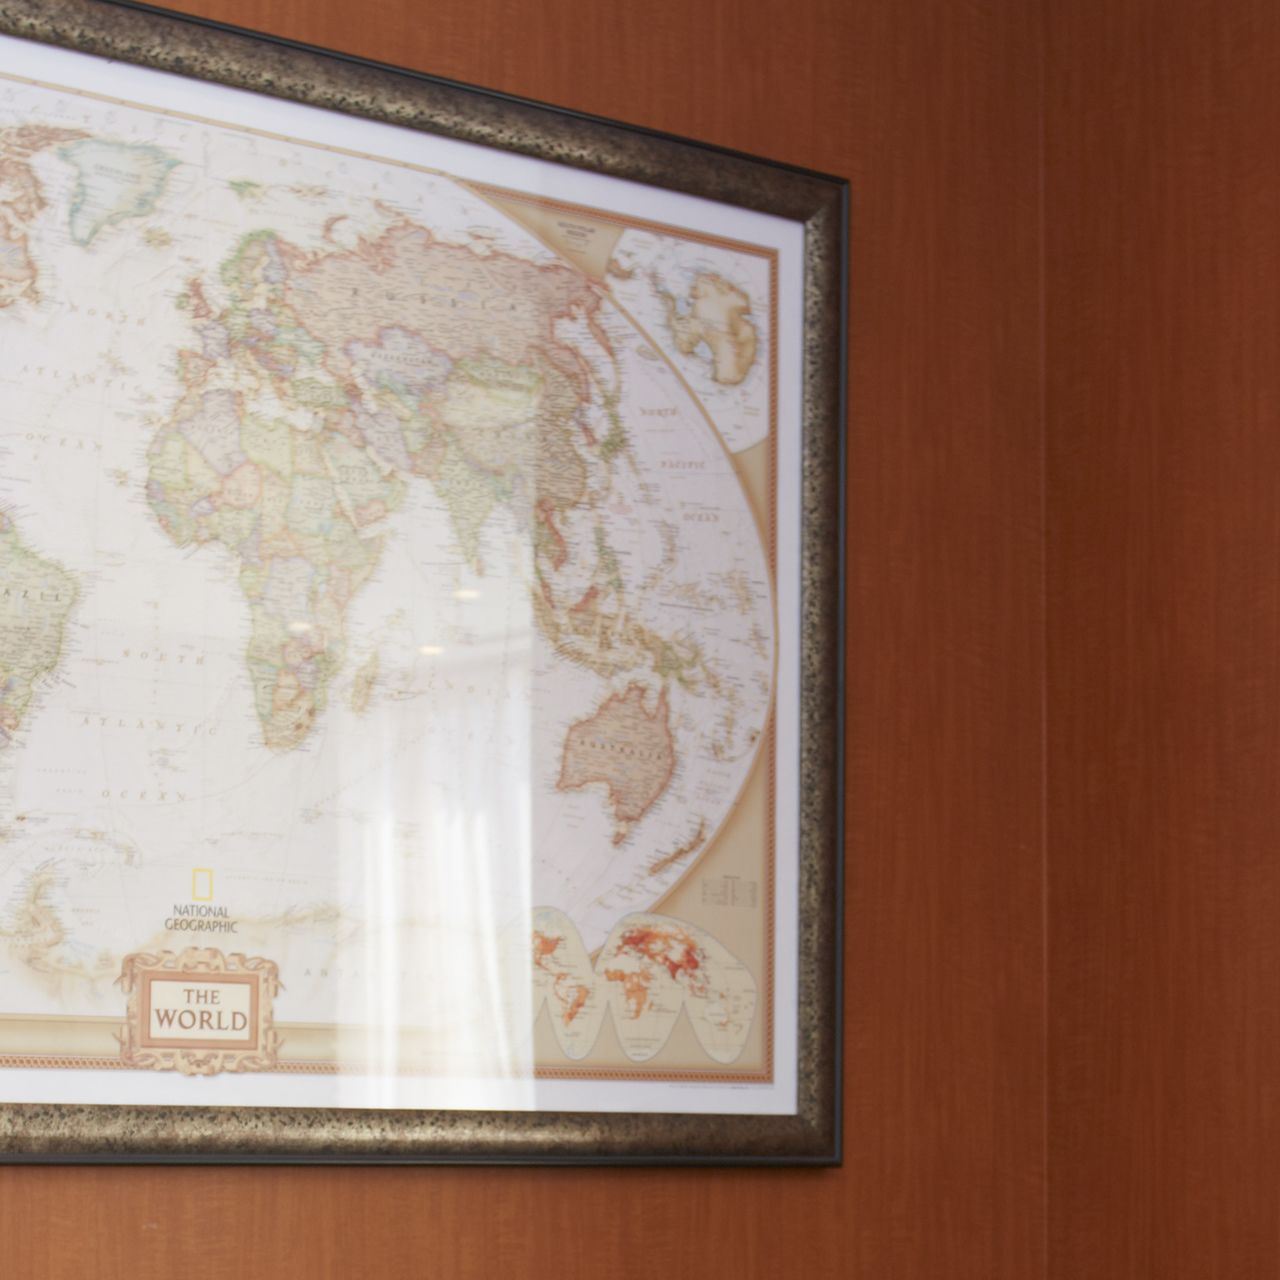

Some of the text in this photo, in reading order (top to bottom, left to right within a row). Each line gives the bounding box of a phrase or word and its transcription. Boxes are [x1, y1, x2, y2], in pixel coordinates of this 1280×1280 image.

[122, 648, 205, 665] SOUTH
[173, 904, 230, 919] NATIONAL
[164, 918, 239, 934] GEOGRAPHIC
[183, 989, 222, 1005] THE
[154, 1008, 248, 1032] WORLD
